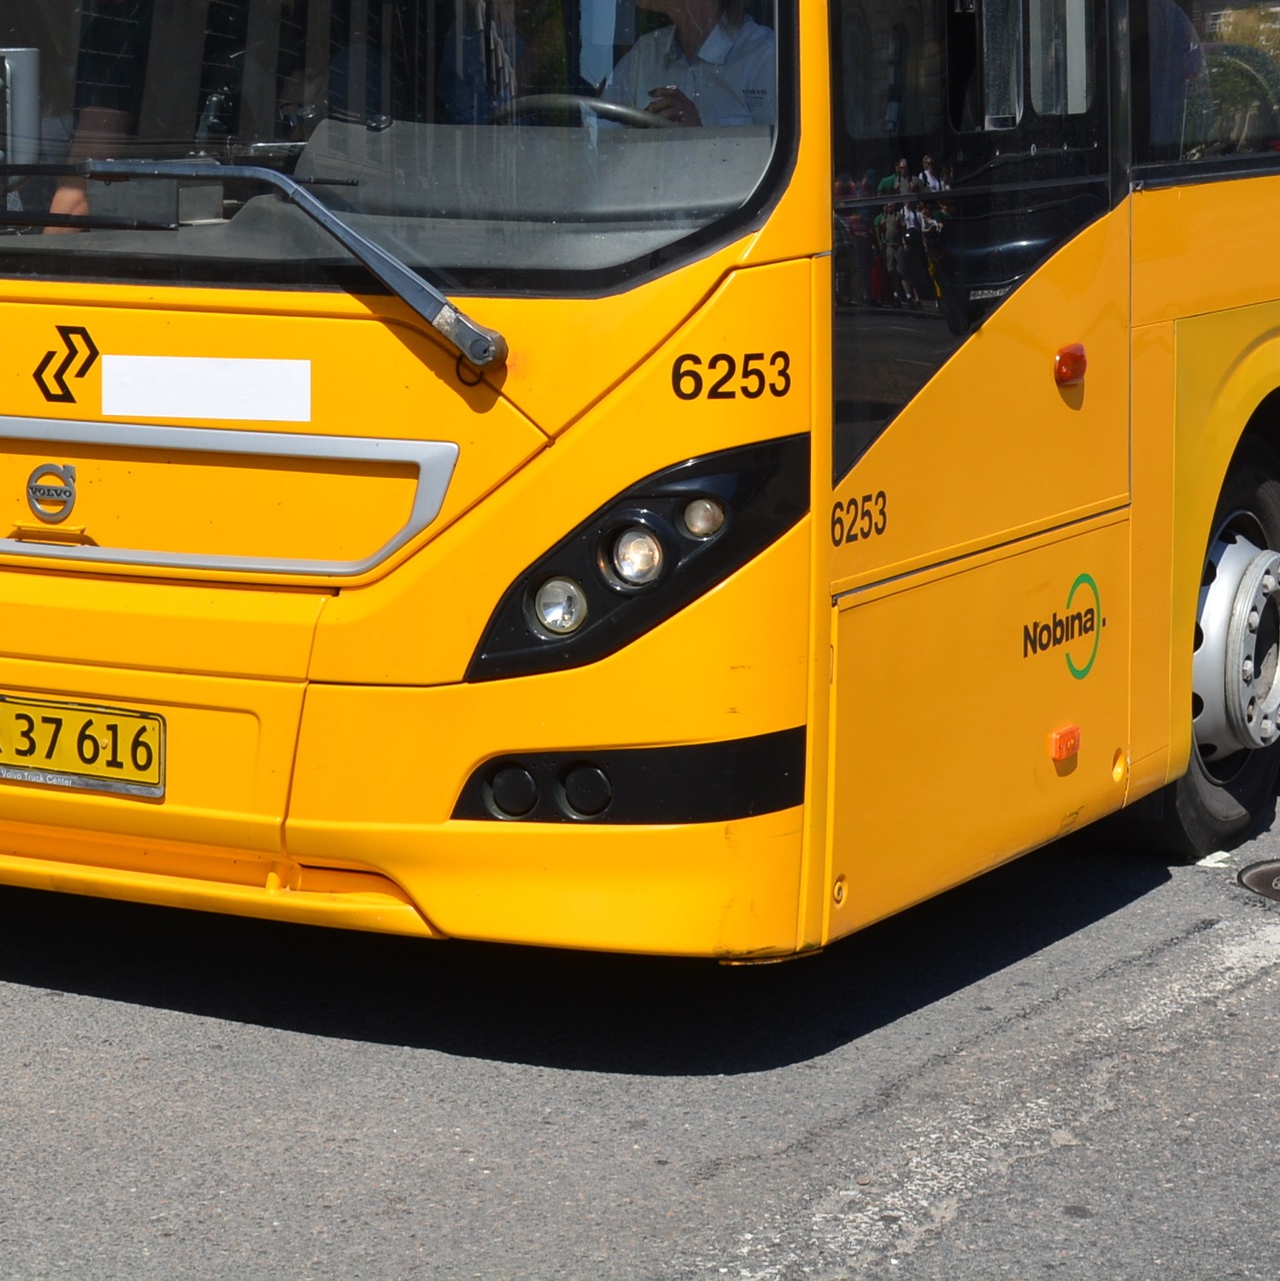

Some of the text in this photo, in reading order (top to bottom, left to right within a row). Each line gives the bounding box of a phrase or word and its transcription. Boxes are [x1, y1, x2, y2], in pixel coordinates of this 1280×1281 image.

[671, 350, 791, 401] 6253
[29, 486, 73, 498] VOLVO
[830, 490, 887, 547] 6253
[1023, 607, 1095, 658] Nobina
[14, 713, 64, 759] 37
[76, 718, 154, 772] 616
[24, 772, 45, 783] Truck
[46, 774, 73, 786] Center
